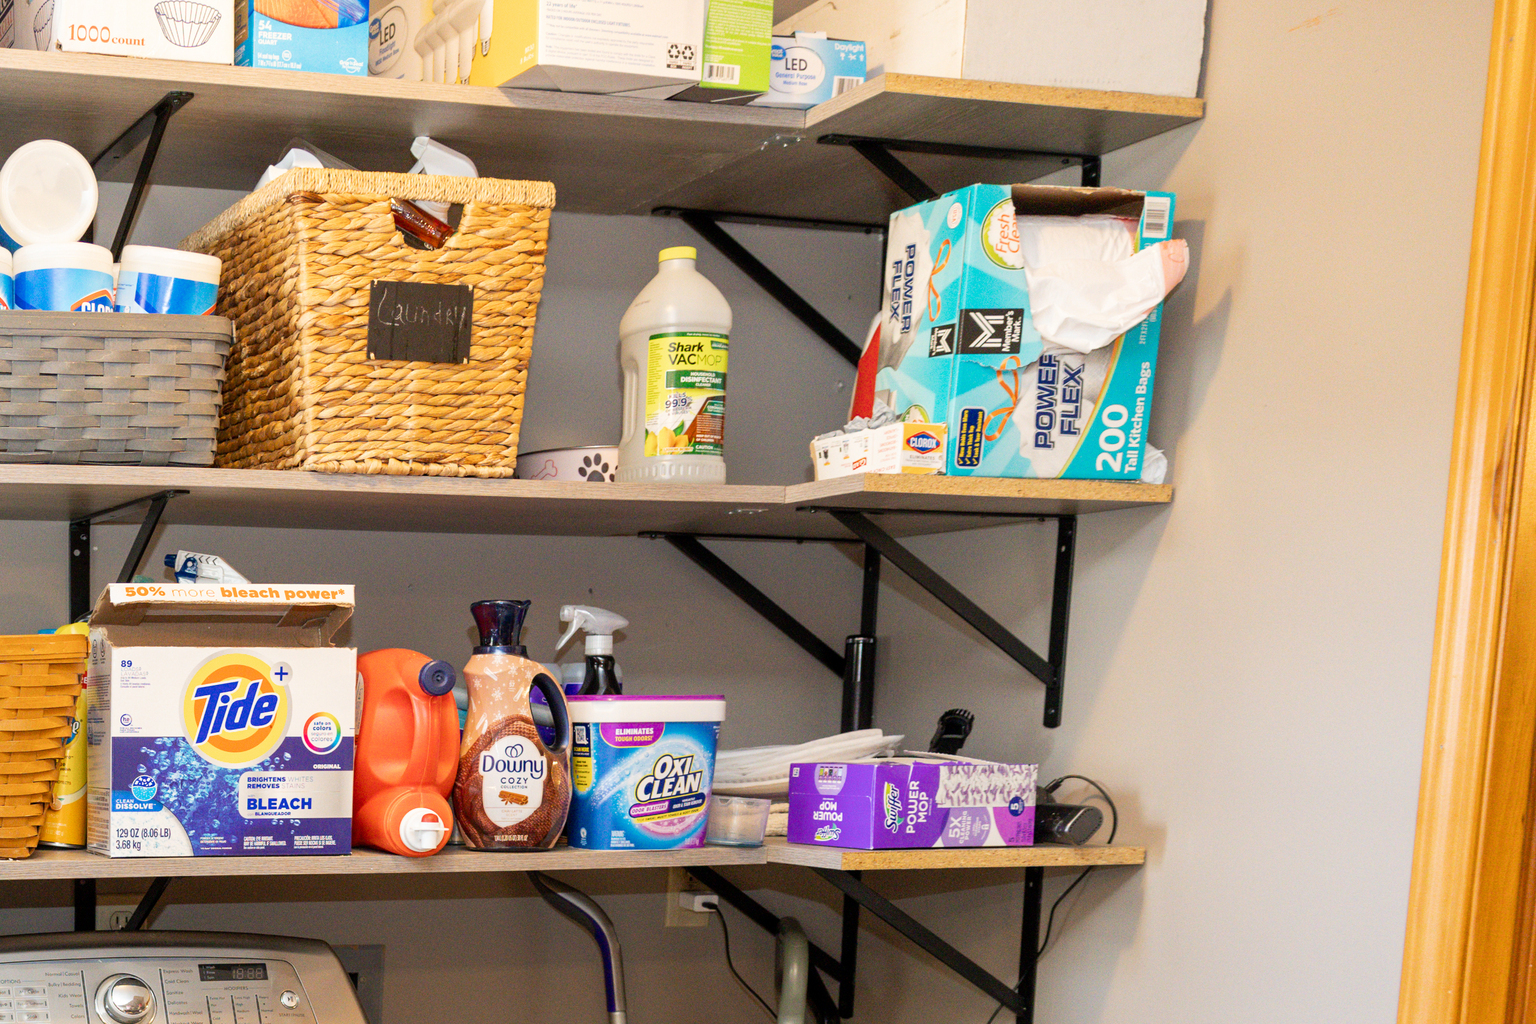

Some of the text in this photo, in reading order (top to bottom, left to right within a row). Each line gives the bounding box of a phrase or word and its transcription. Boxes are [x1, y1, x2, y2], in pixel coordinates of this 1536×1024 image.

[68, 24, 145, 46] 1000 count
[258, 20, 272, 30] 54
[258, 31, 292, 40] FREEZER
[380, 22, 396, 46] LED
[834, 43, 864, 53] Daylight
[784, 58, 808, 71] LED
[996, 214, 1010, 254] Fresh
[889, 260, 903, 324] FLEX
[900, 243, 916, 334] POWER
[1002, 310, 1014, 352] Member's
[668, 342, 704, 352] Shark
[1060, 364, 1085, 436] FLEX
[1125, 362, 1152, 474] Tall Kitchen Bags
[910, 438, 936, 448] CLOROX
[1096, 404, 1129, 472] 200
[125, 586, 166, 598] 50%
[172, 588, 215, 598] more
[220, 587, 280, 600] bleach
[120, 660, 132, 668] 89
[193, 680, 279, 744] Tide
[616, 728, 654, 736] ELIMINATES
[482, 754, 544, 780] Downy
[654, 755, 693, 780] OXI
[636, 771, 703, 802] CLEAN
[247, 798, 312, 810] BLEACH
[646, 804, 666, 812] BLASTERS
[819, 801, 838, 810] MOP
[885, 784, 902, 834] Swiffer
[906, 781, 920, 834] POWER
[917, 792, 929, 822] MOP
[1010, 802, 1019, 810] 5
[813, 811, 843, 822] POWER
[948, 816, 962, 838] 5X
[959, 810, 968, 844] CLEANING
[116, 828, 171, 839] 129 OZ (8.06 LB)
[815, 825, 841, 840] Swiffer
[116, 840, 142, 851] 3.68 kg
